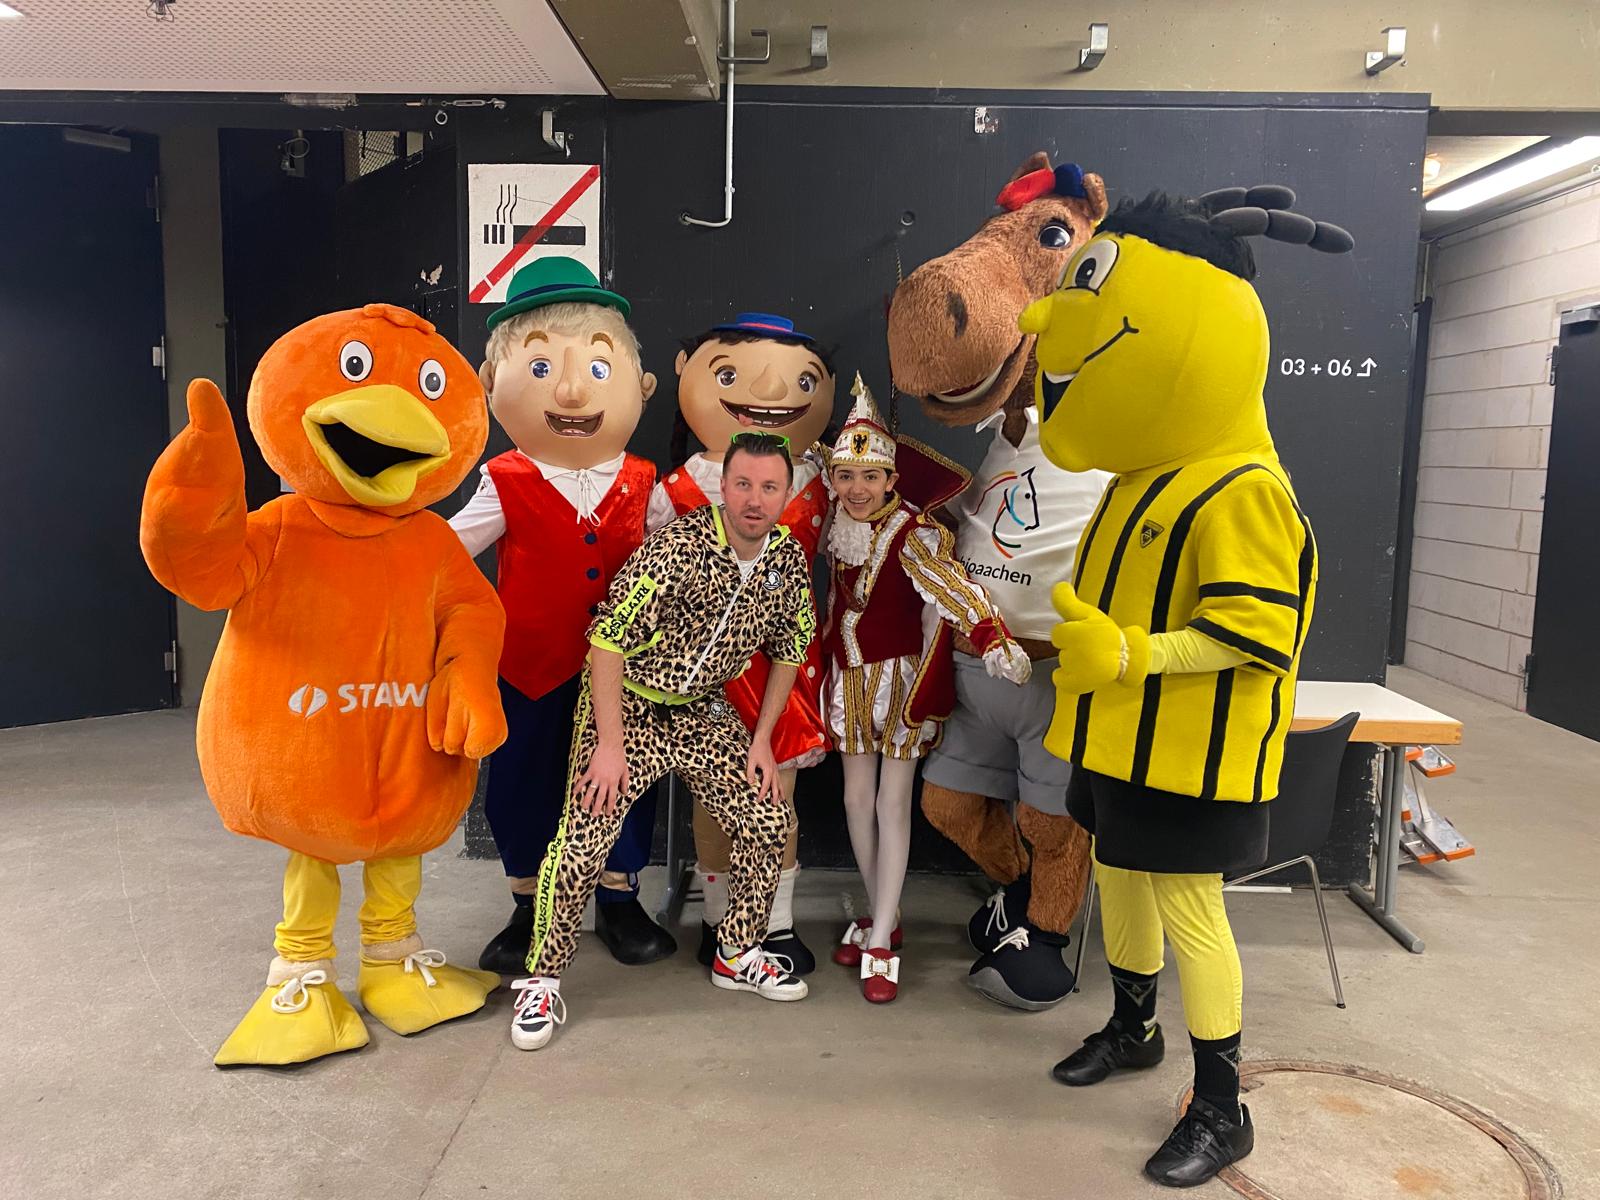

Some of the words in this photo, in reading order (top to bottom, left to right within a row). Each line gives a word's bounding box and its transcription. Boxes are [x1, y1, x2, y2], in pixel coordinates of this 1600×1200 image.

[1281, 358, 1306, 376] 03
[1310, 363, 1322, 375] +
[1327, 358, 1352, 377] 06
